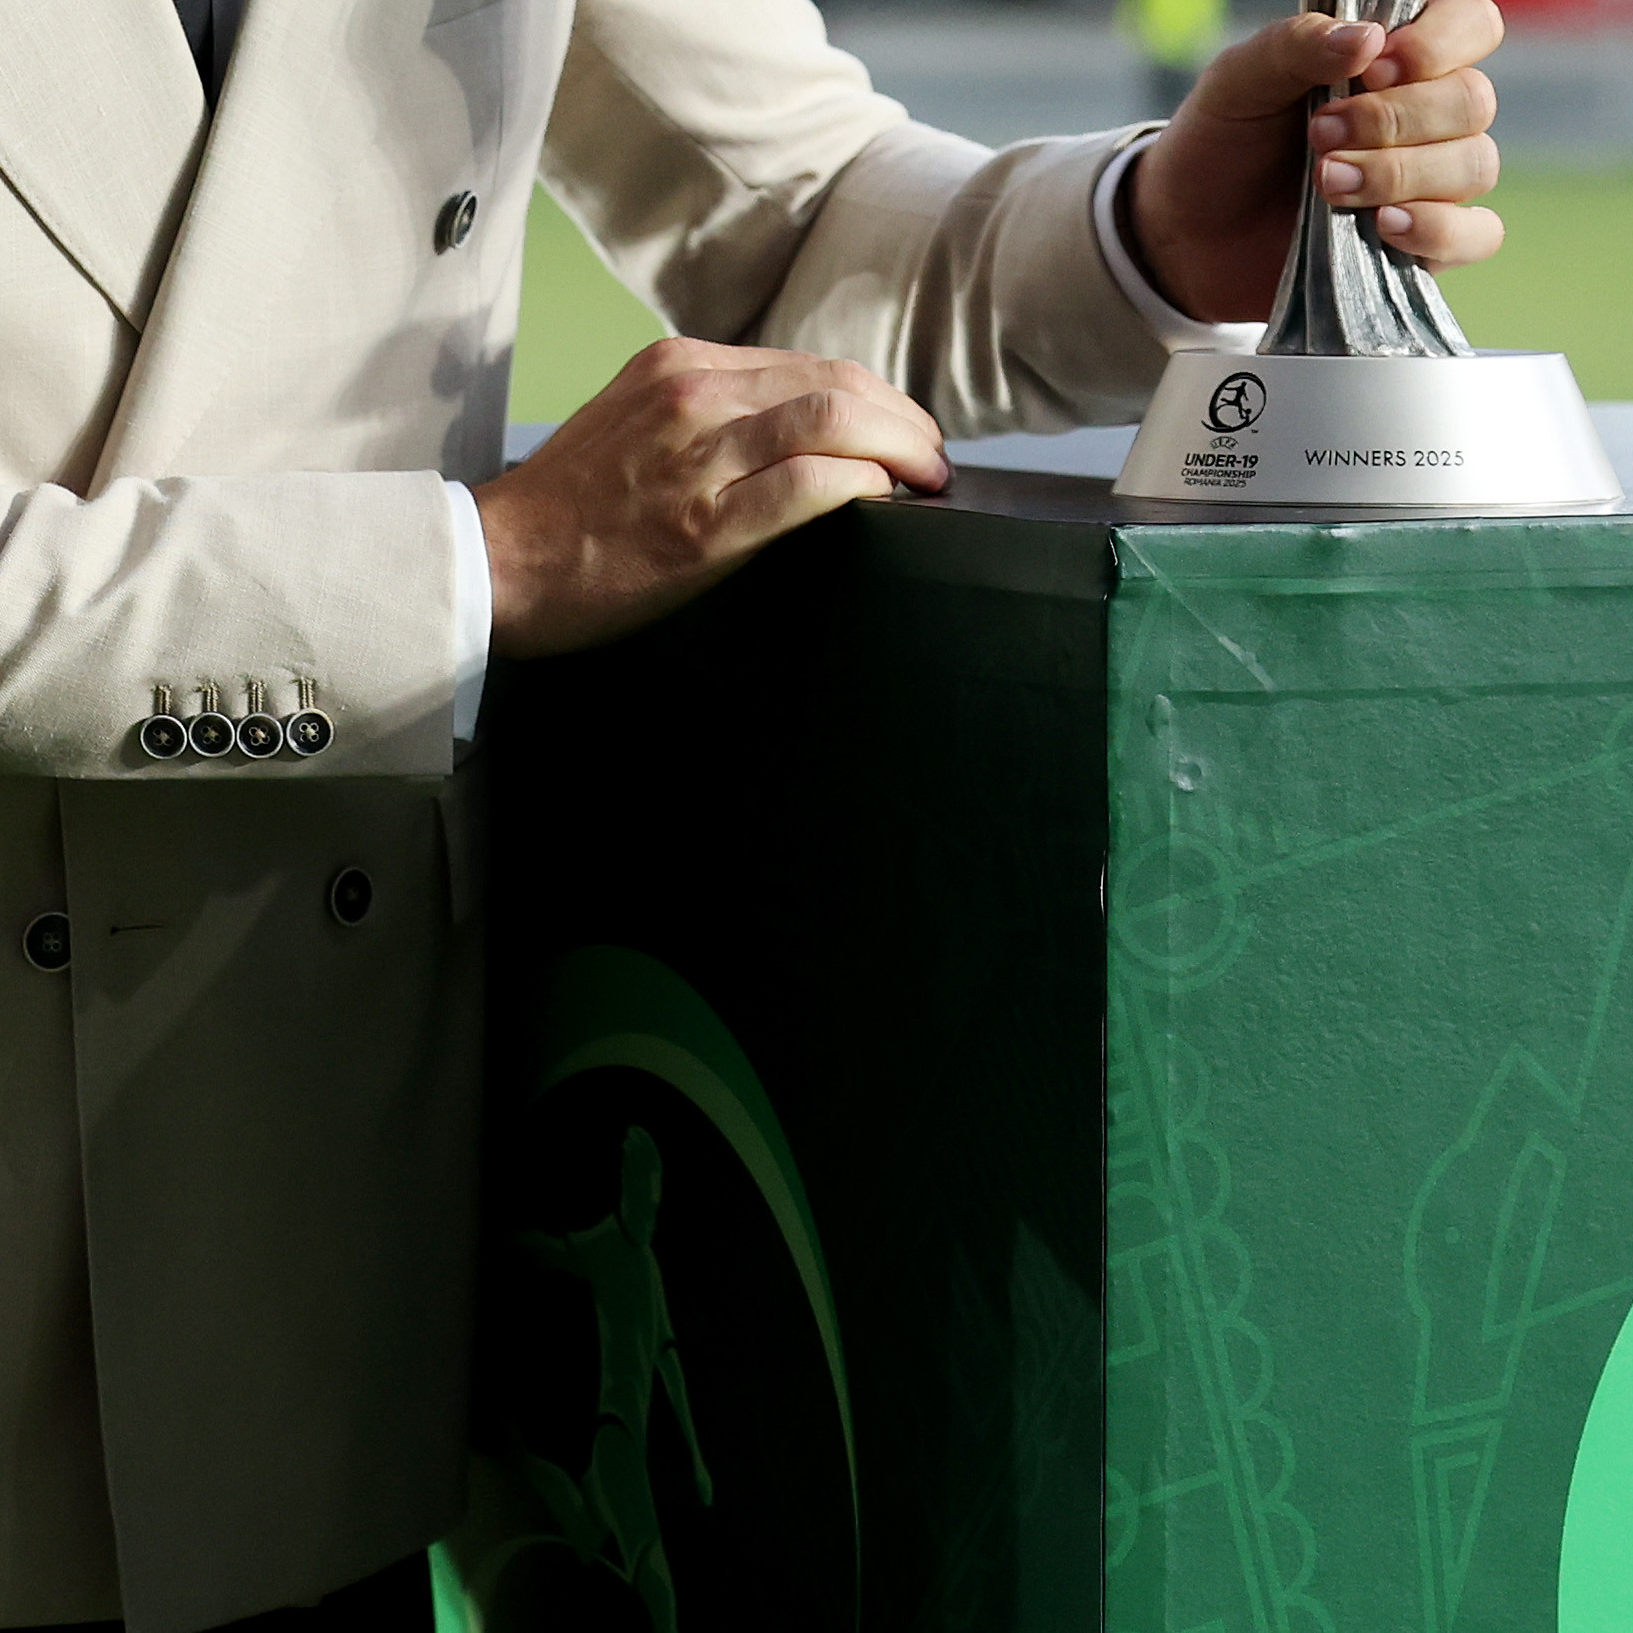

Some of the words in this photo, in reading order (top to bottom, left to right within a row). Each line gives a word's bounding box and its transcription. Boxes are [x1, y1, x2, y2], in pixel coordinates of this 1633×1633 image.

[1210, 436, 1238, 450] UEFA
[1184, 453, 1259, 468] UNDER-19
[1304, 449, 1406, 467] WINNERS
[1413, 450, 1465, 467] 2025
[1180, 467, 1257, 479] CHAMPIONSHIP
[1183, 477, 1222, 487] ROMANIA
[1222, 478, 1247, 488] 2025
